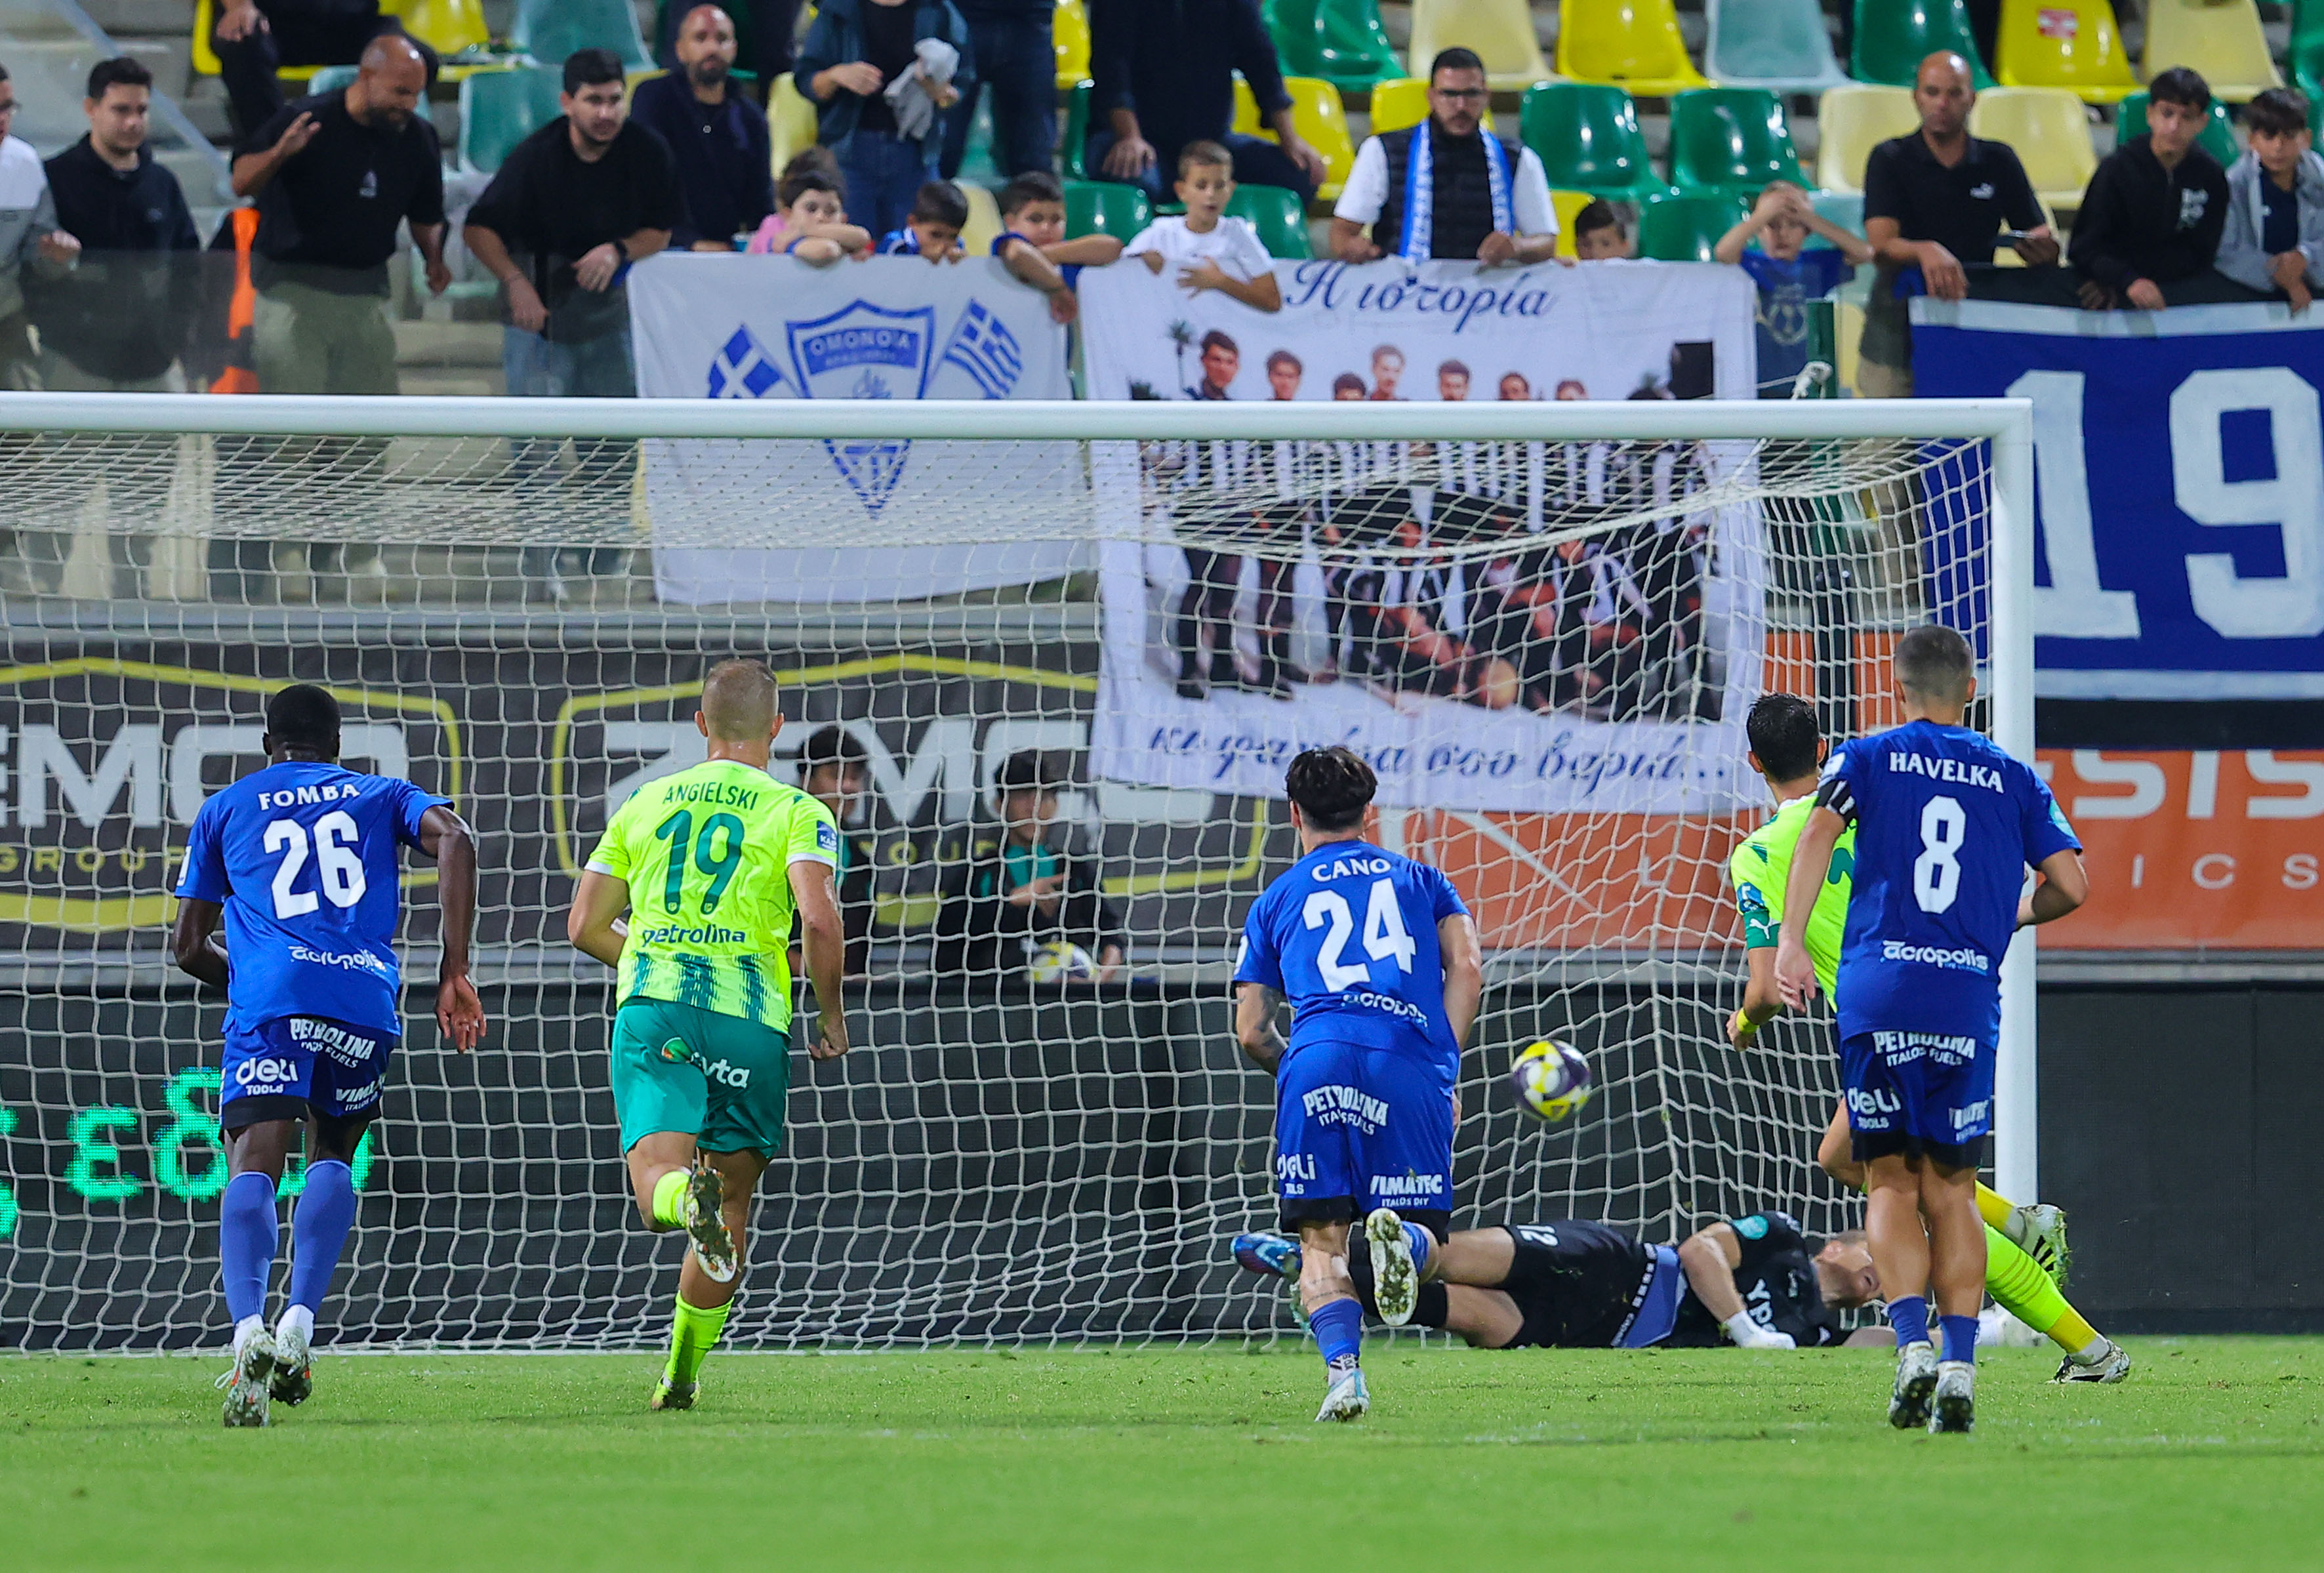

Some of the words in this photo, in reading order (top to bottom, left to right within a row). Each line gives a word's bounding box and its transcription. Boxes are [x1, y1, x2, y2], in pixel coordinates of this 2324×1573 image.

[1358, 273, 1550, 333] ιστορία
[258, 783, 360, 811] FOMBA
[663, 782, 759, 811] ANGIELSKI
[1890, 751, 2005, 794] HAVELKA
[2035, 749, 2324, 819] SIS
[263, 809, 367, 920] 26
[655, 809, 745, 915] 19
[1312, 858, 1391, 882] CANO
[1913, 794, 1967, 914] 8
[642, 924, 746, 947] petrolina
[1302, 877, 1416, 994] 24
[1516, 1224, 1559, 1247] 12
